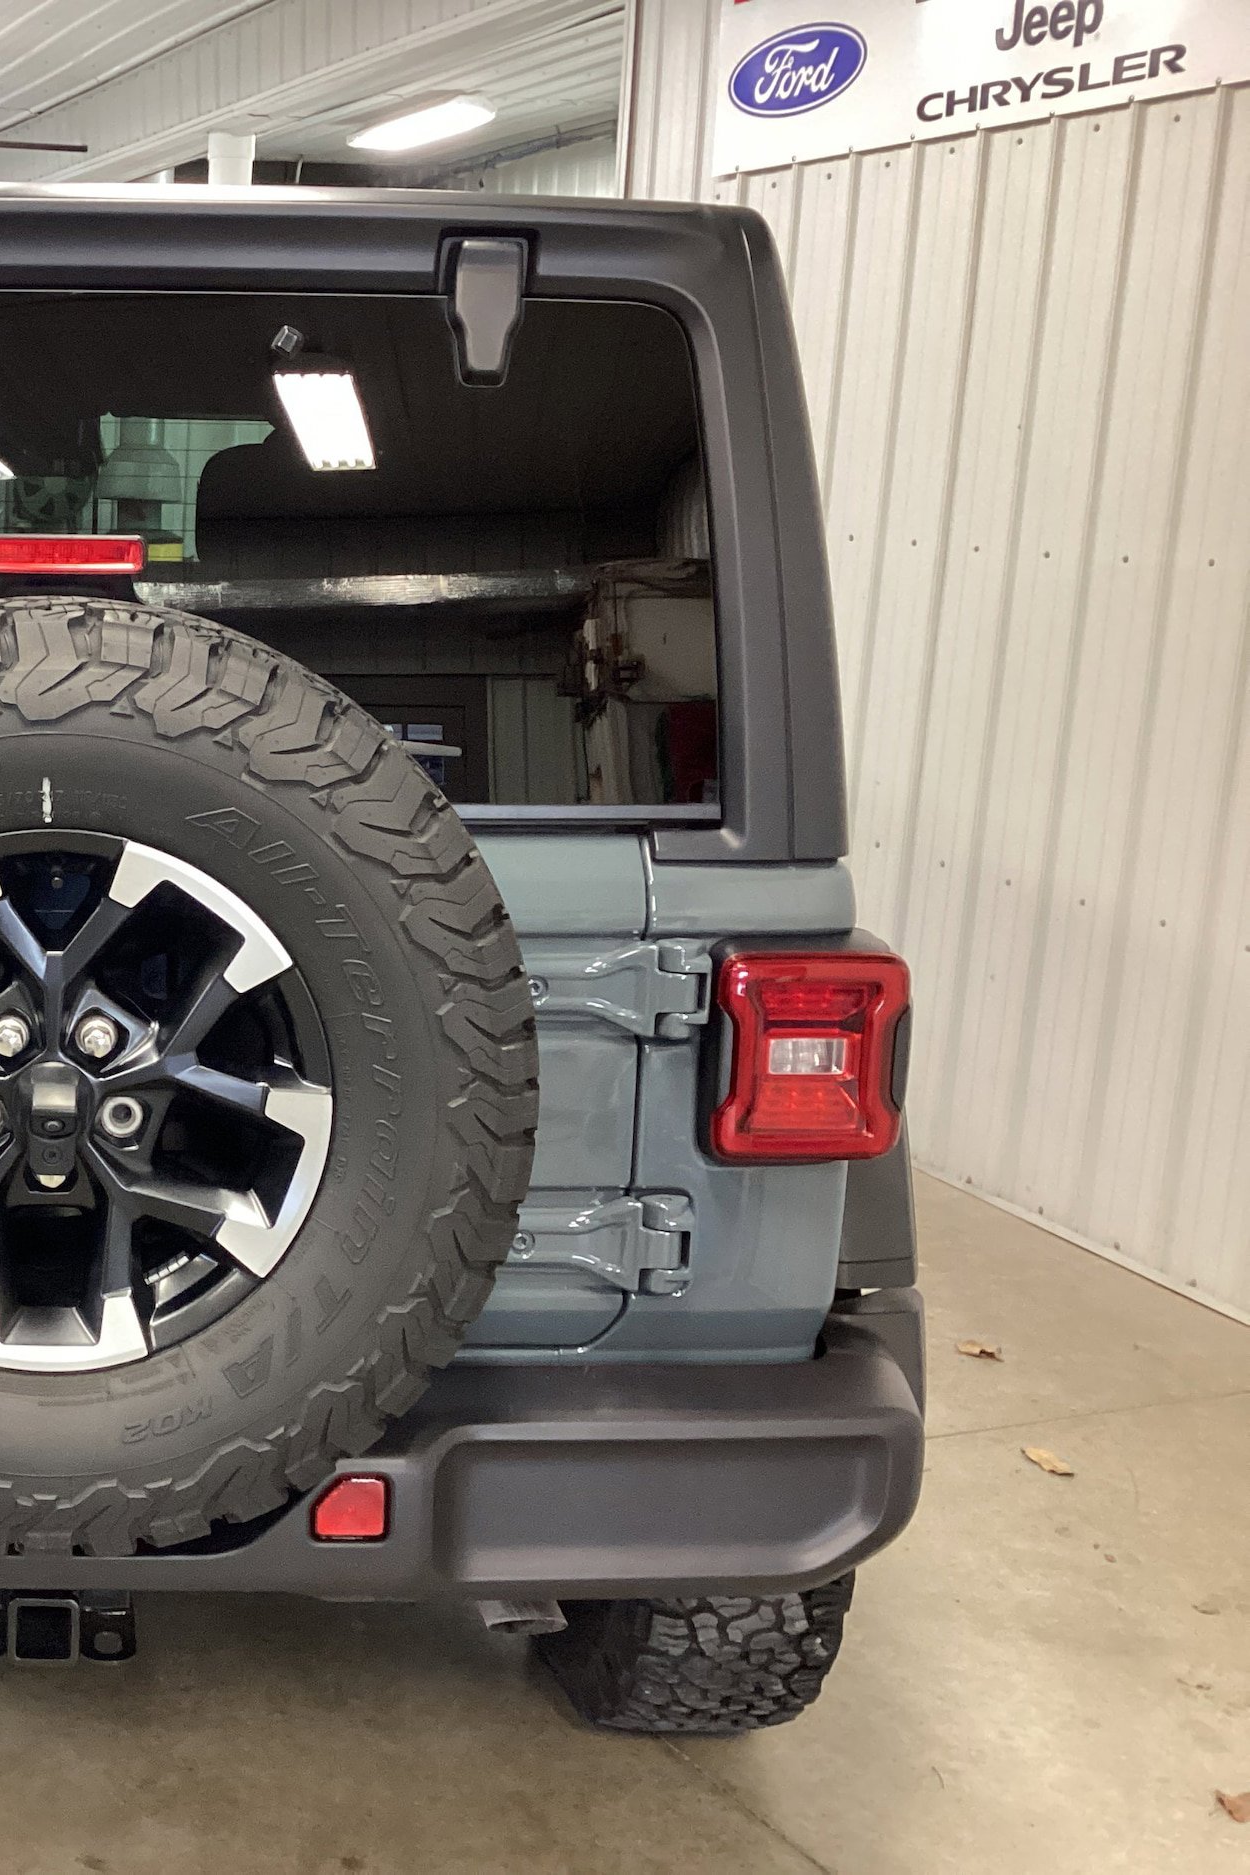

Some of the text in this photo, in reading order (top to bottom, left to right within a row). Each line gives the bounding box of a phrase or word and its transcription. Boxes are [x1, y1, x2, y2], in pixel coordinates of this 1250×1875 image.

[995, 0, 1104, 51] Jeep
[754, 38, 837, 104] Ford
[916, 44, 1187, 122] CHRYSLER
